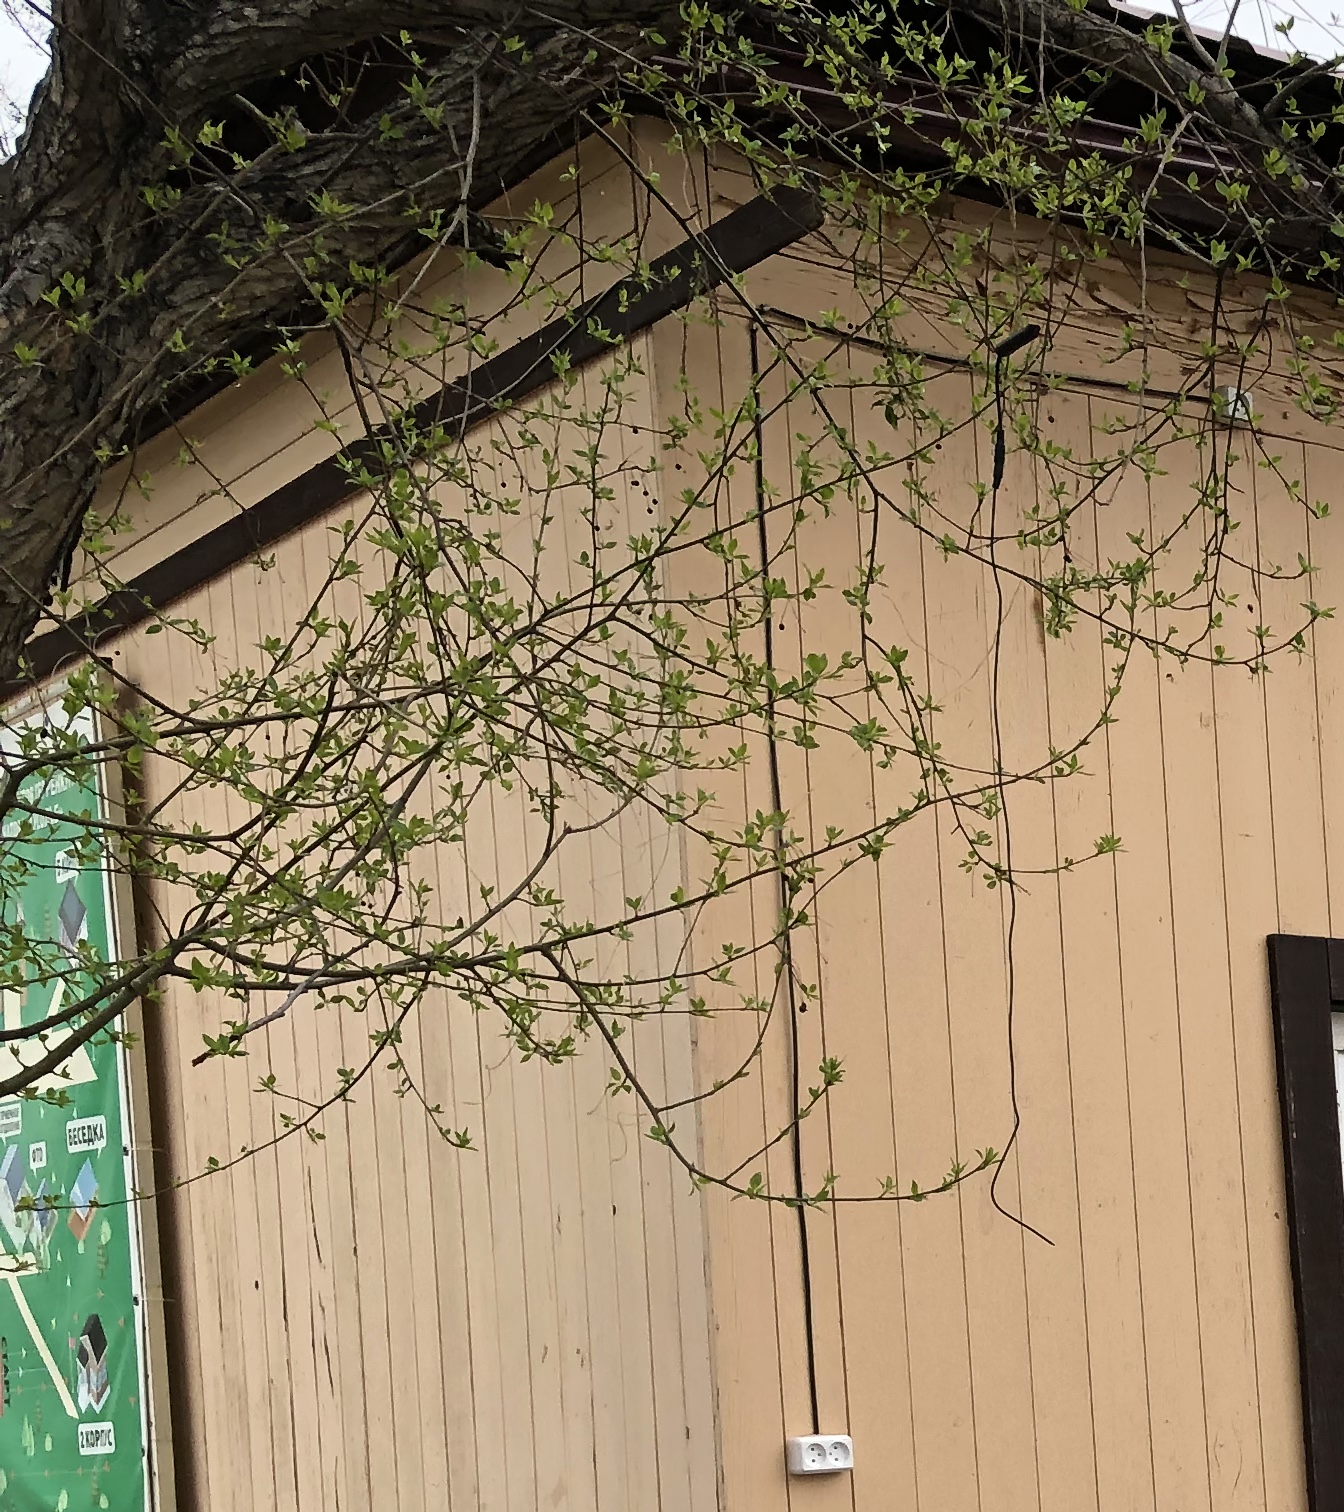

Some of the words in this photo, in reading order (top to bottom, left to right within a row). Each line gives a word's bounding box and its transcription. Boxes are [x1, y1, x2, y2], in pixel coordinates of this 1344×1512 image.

[68, 1123, 104, 1147] БЕСЕДКА
[80, 1431, 85, 1448] 2
[85, 1429, 112, 1448] КОРПУС
